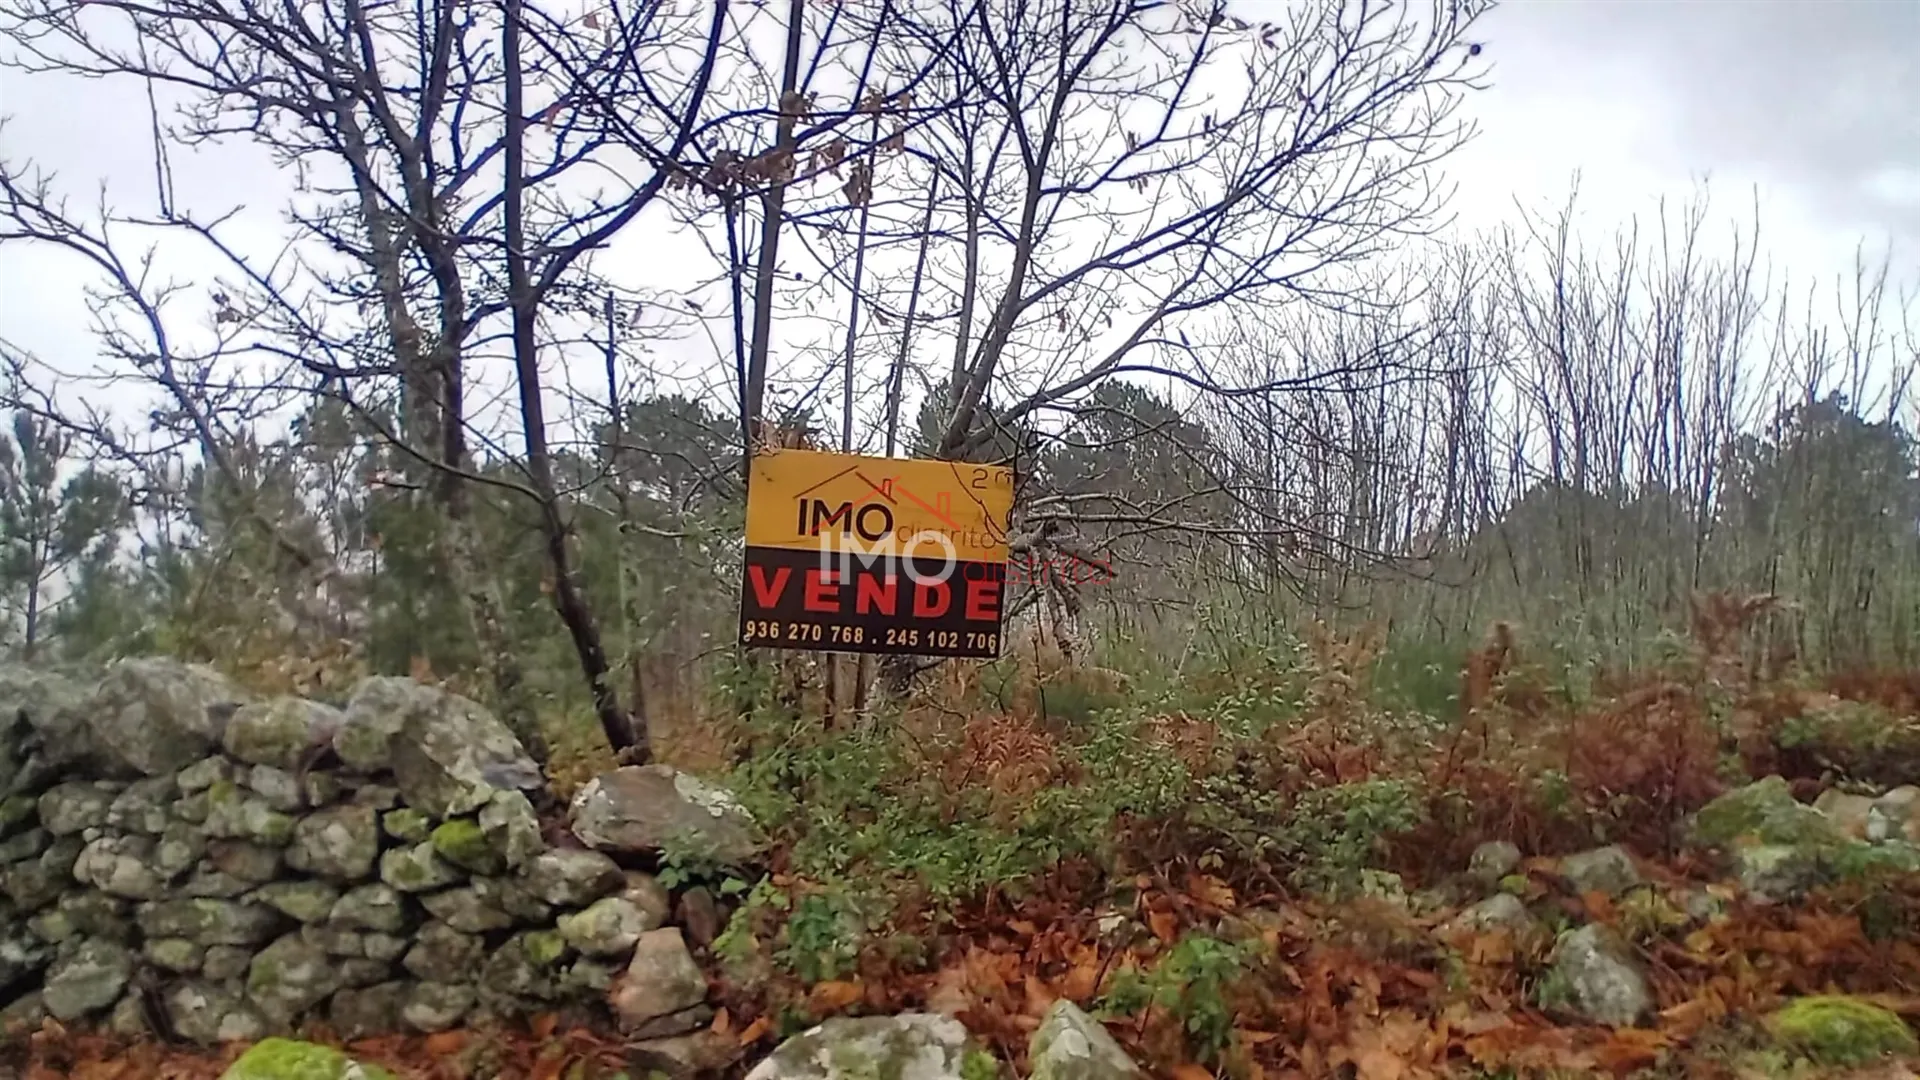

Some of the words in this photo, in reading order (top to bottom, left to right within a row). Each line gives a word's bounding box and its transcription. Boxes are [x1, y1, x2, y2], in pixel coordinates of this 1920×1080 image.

[798, 499, 894, 542] IMO
[897, 523, 997, 549] distrito
[748, 565, 999, 621] VENDE
[745, 621, 779, 639] 936
[788, 623, 821, 641] 270
[831, 626, 864, 643] 768
[886, 629, 918, 646] 245
[927, 631, 958, 648] 102
[966, 633, 997, 650] 706
